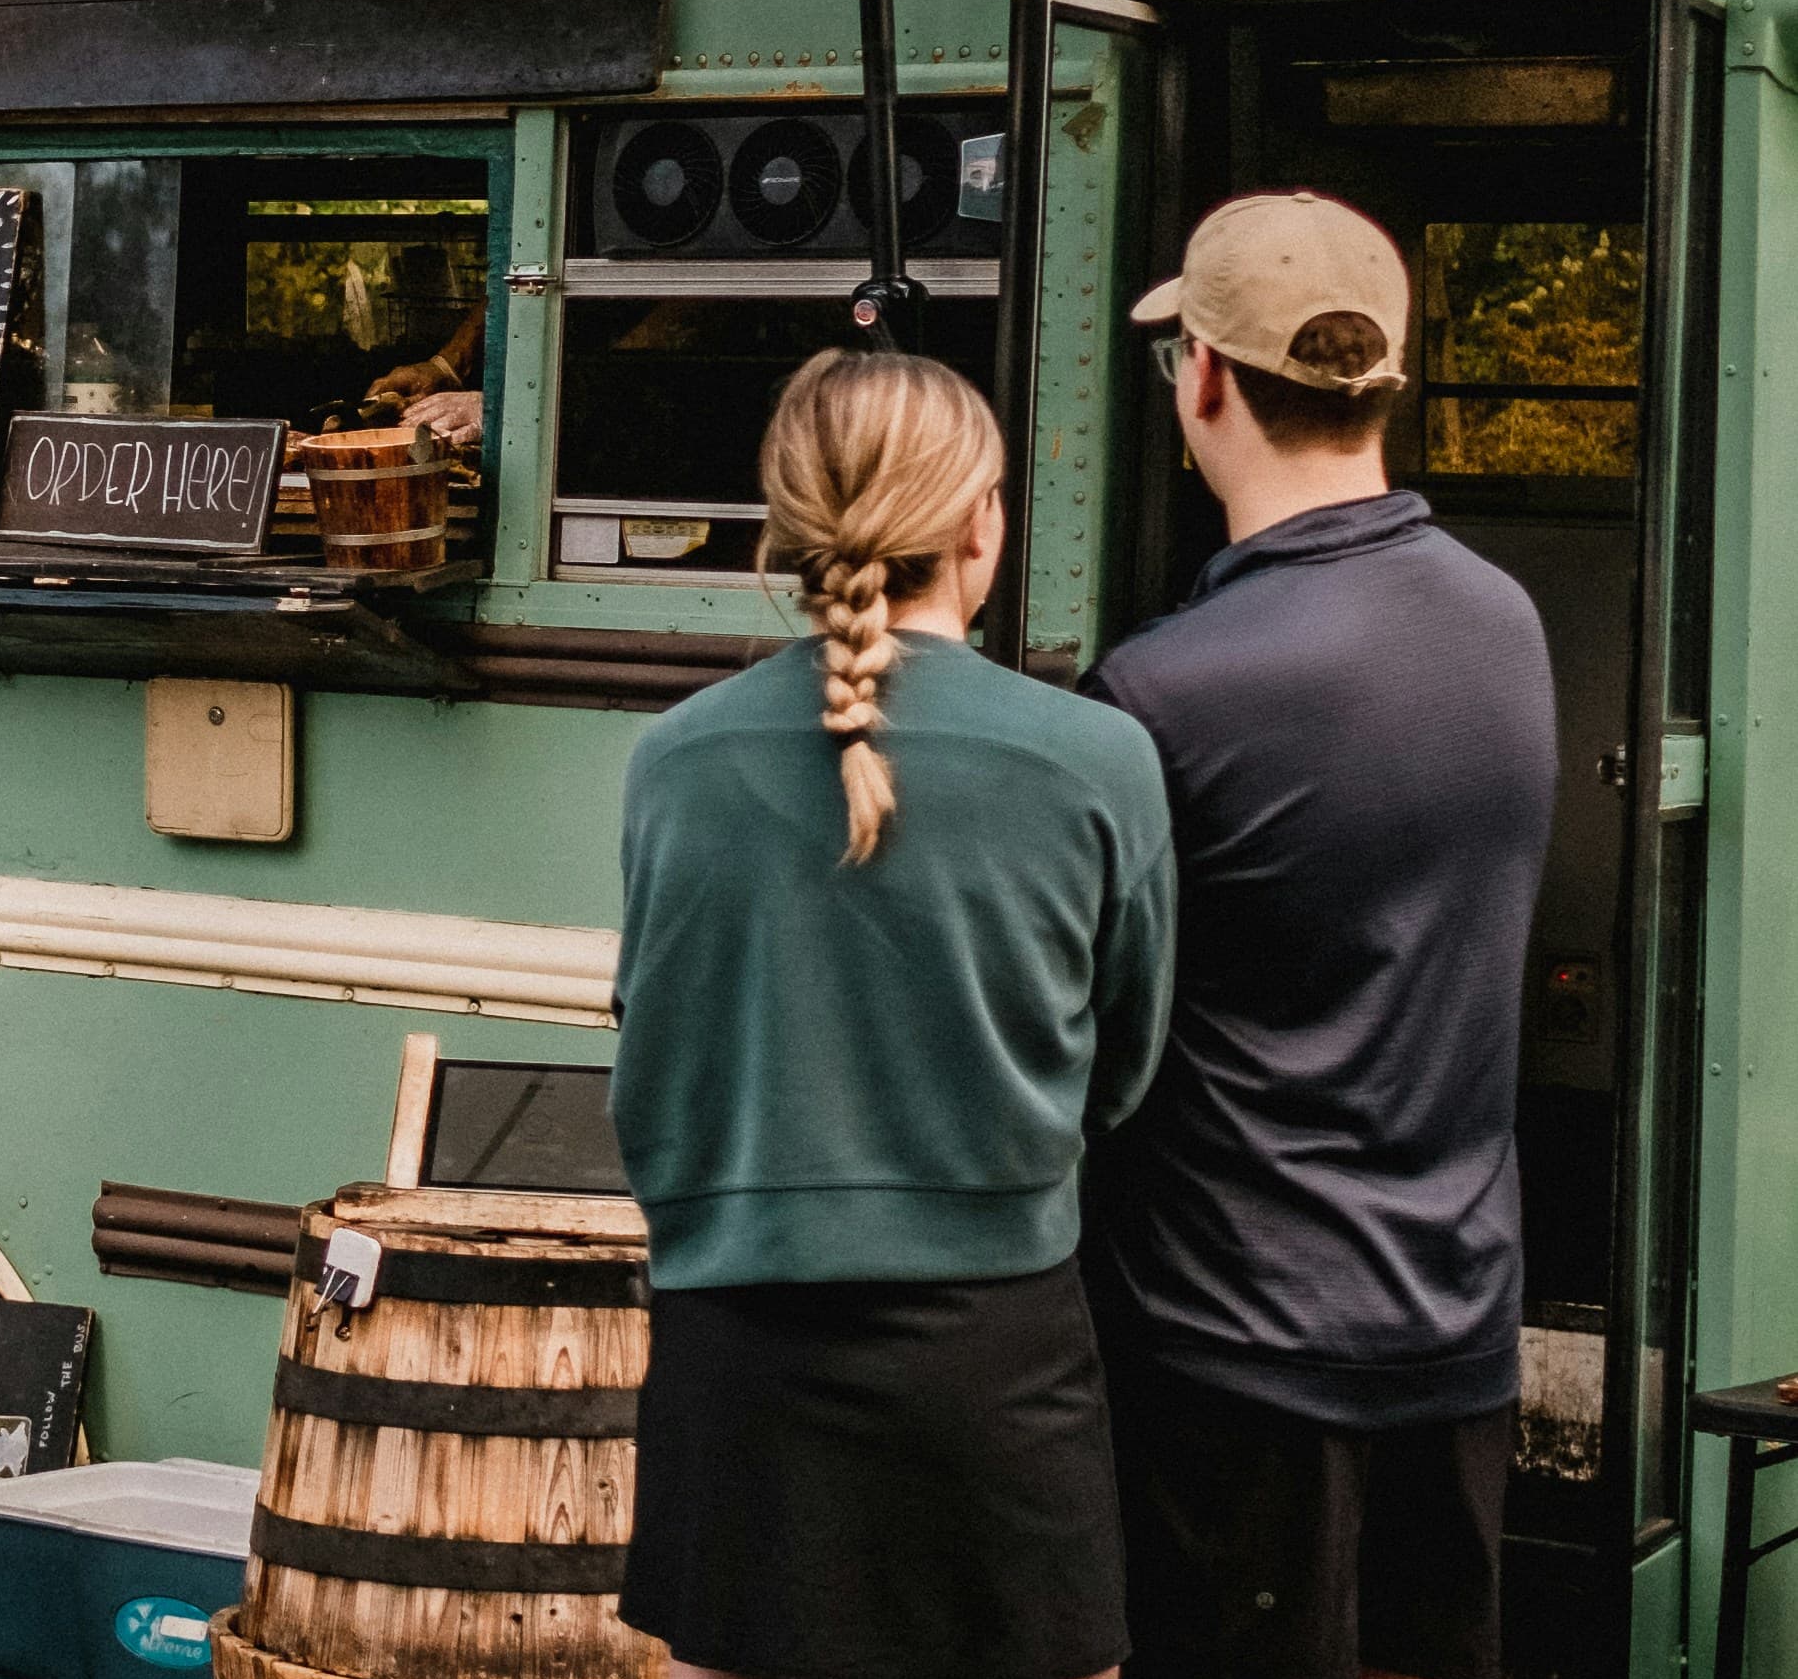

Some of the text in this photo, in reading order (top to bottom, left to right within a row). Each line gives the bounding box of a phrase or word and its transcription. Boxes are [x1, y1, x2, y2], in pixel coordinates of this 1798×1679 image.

[27, 436, 153, 514] ORDER
[38, 1390, 57, 1448] FOLLOW
[60, 1360, 73, 1388] THE
